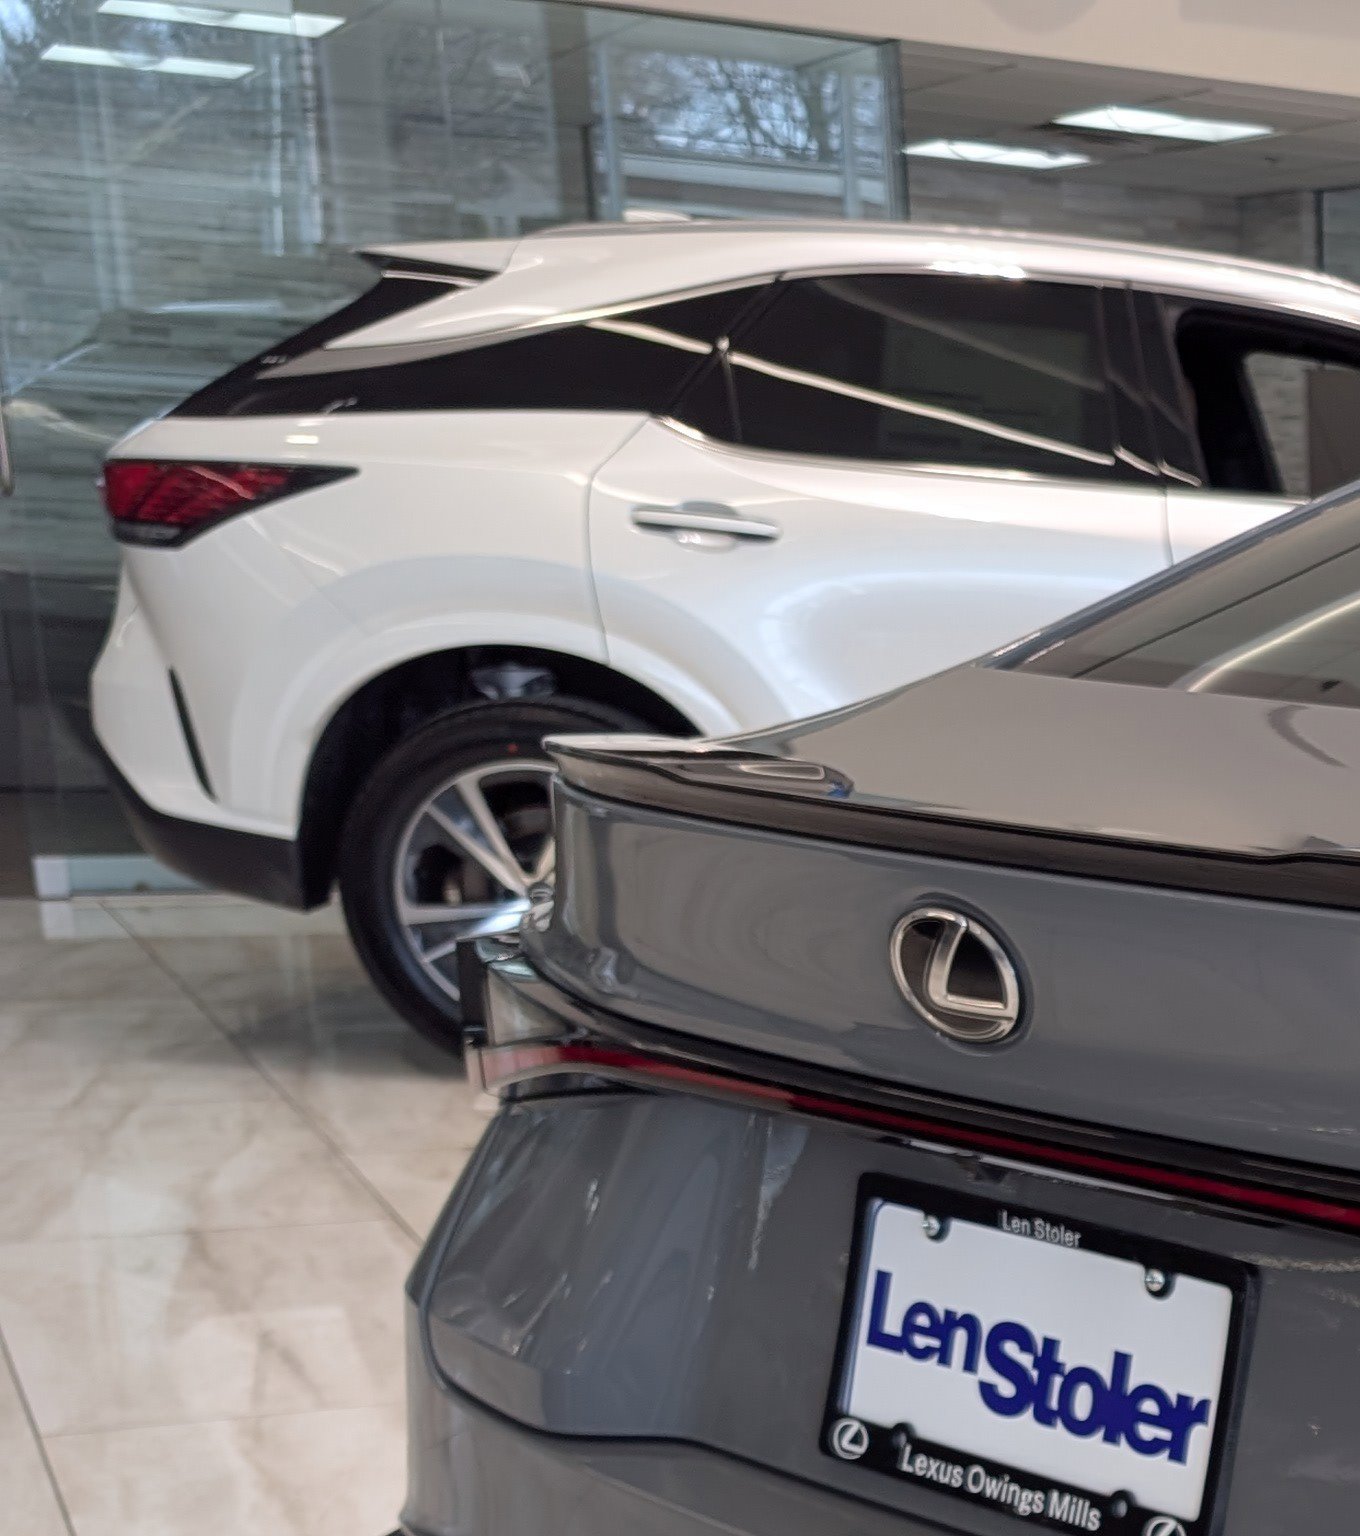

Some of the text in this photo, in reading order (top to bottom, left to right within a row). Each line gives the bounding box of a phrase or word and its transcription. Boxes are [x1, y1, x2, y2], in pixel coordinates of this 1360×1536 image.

[1001, 1210, 1082, 1249] Len Stoler
[866, 1270, 1211, 1466] LenStoler
[901, 1443, 1101, 1532] Lexus Owings Mills
